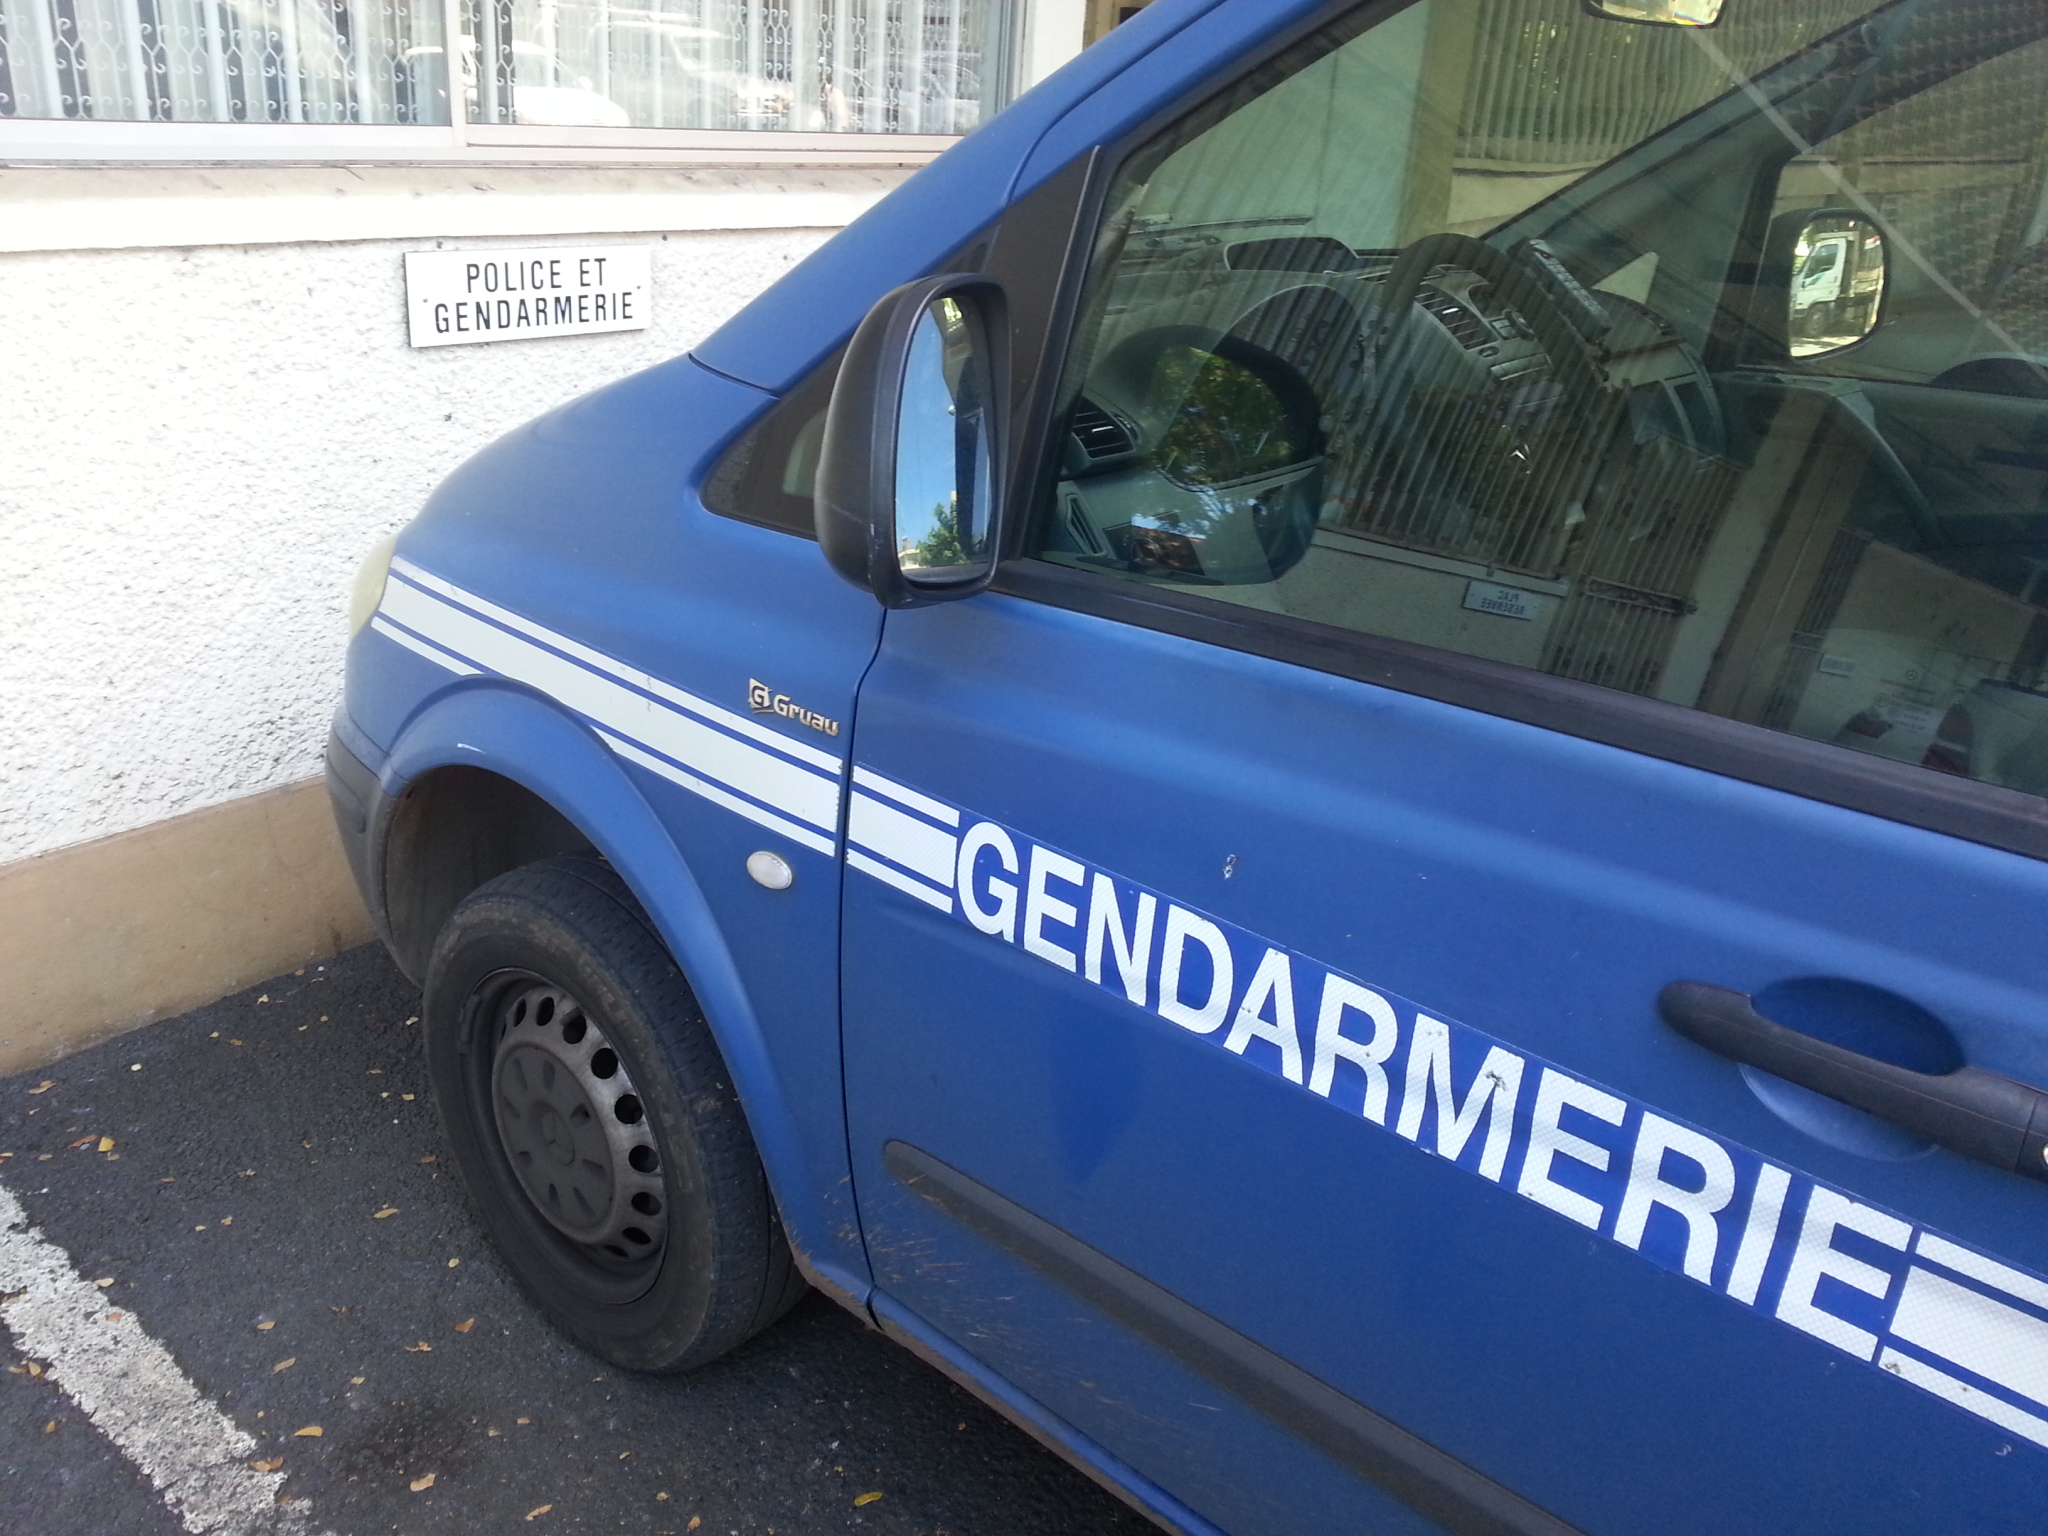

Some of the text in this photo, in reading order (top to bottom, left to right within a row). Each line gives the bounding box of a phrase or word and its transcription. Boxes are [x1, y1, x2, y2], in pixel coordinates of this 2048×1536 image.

[466, 258, 607, 293] POLICE ET
[434, 292, 633, 333] GENDARMERIE
[773, 694, 839, 737] Gruau
[957, 821, 1913, 1362] GENDARMERIE
